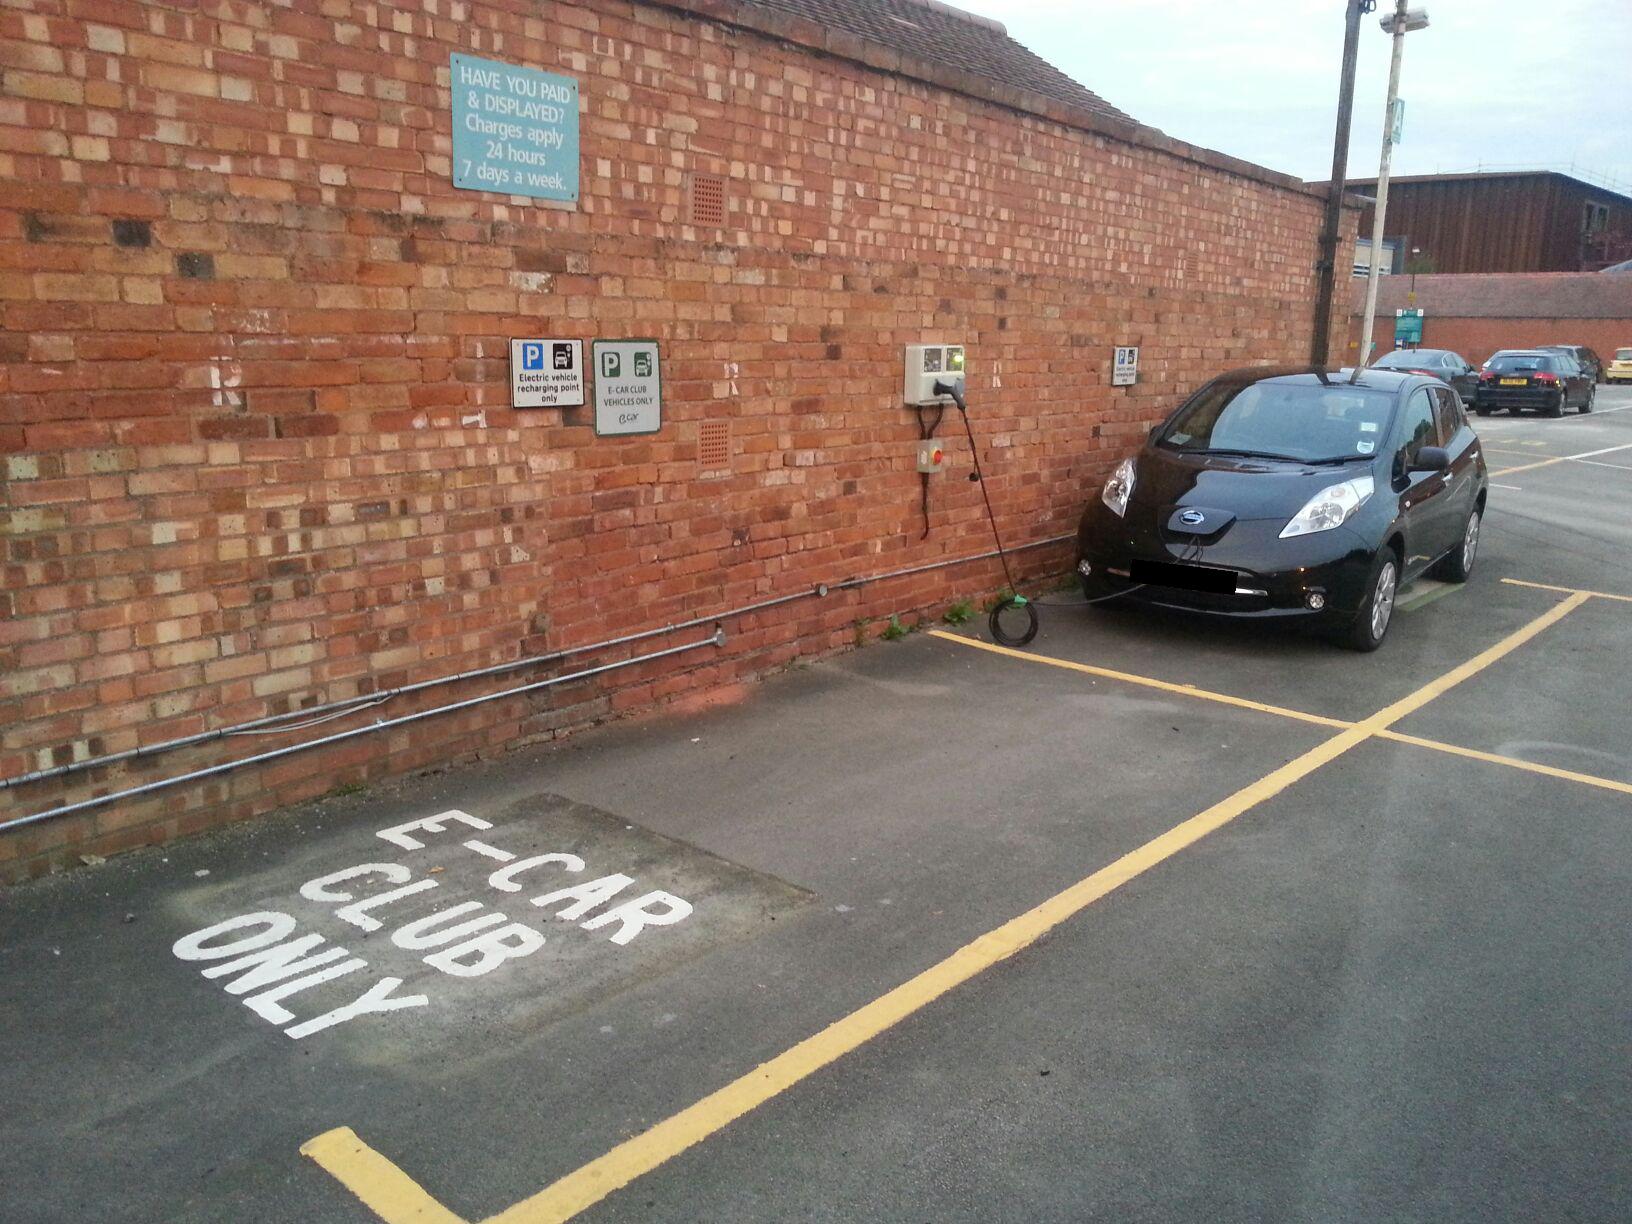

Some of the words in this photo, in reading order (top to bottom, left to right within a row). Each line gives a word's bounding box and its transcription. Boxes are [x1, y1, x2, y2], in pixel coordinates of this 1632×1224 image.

[461, 66, 500, 91] HAVE
[506, 75, 536, 97] YOU
[541, 82, 570, 104] PAID
[468, 90, 479, 109] &
[485, 94, 564, 124] DISPLAYED?
[466, 113, 522, 141] Charges
[527, 127, 564, 150] apply
[486, 140, 502, 160] 24
[508, 144, 546, 166] hours
[462, 160, 472, 177] 7
[477, 162, 509, 186] days
[514, 173, 522, 185] a
[527, 172, 567, 191] week.
[526, 345, 539, 367] P
[604, 353, 618, 376] P
[517, 384, 558, 393] recharging
[561, 383, 579, 392] point
[519, 373, 549, 382] Electric
[552, 373, 577, 382] vehicle
[630, 384, 647, 394] CLUB
[541, 394, 558, 403] only
[603, 398, 635, 406] VEHICLES
[636, 396, 653, 405] ONLY
[375, 809, 694, 946] E-CAR
[299, 862, 546, 977] CLUB
[172, 910, 429, 1039] ONLY
